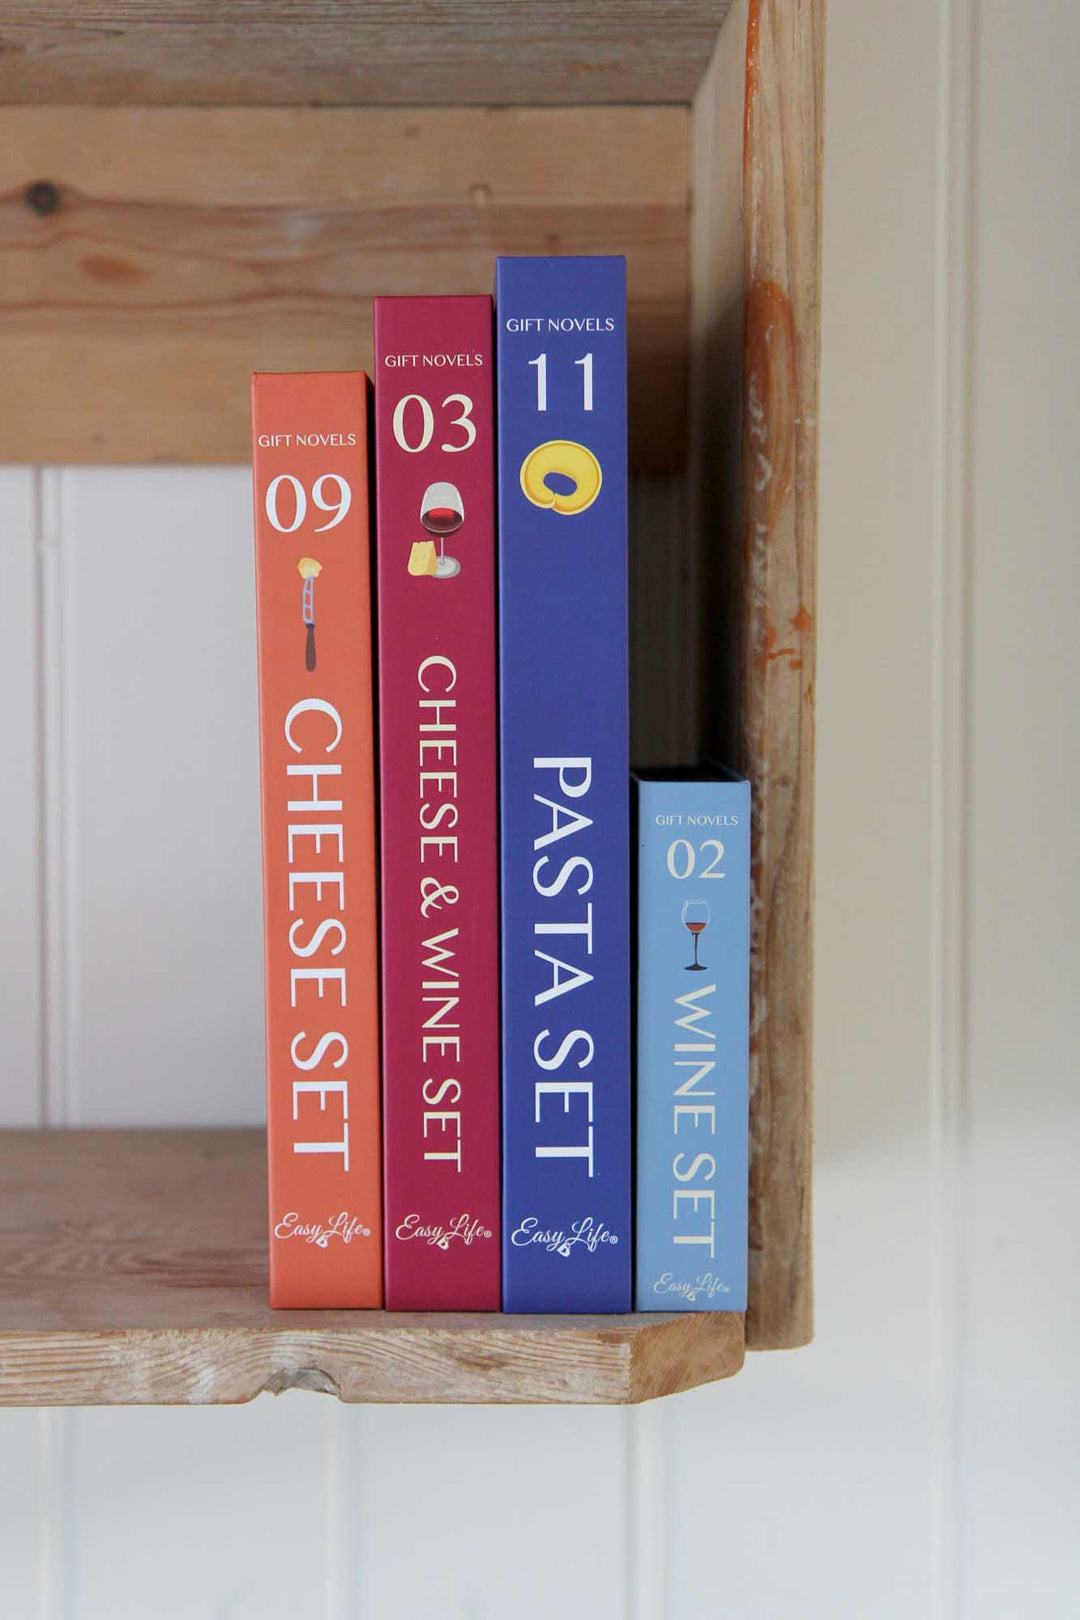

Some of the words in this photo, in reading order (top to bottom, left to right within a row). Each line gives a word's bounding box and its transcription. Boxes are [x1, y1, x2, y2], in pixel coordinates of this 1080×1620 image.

[384, 353, 420, 368] GIFT
[422, 353, 483, 368] NOVELS
[506, 317, 545, 332] GIFT
[547, 317, 615, 332] NOVELS
[528, 352, 593, 412] 11
[257, 433, 293, 448] GIFT
[295, 433, 357, 448] NOVELS
[392, 393, 477, 453] 03
[265, 473, 352, 533] 09
[417, 655, 459, 863] CHEESE
[284, 698, 347, 1008] CHEESE
[655, 814, 684, 827] GIFT
[687, 814, 739, 827] NOVELS
[420, 877, 459, 918] &
[532, 757, 594, 1007] PASTA
[666, 839, 726, 880] 02
[421, 927, 460, 1063] WINE
[673, 983, 716, 1135] WINE
[290, 1031, 350, 1172] SET
[422, 1078, 462, 1173] SET
[533, 1029, 595, 1178] SET
[672, 1152, 716, 1259] SET
